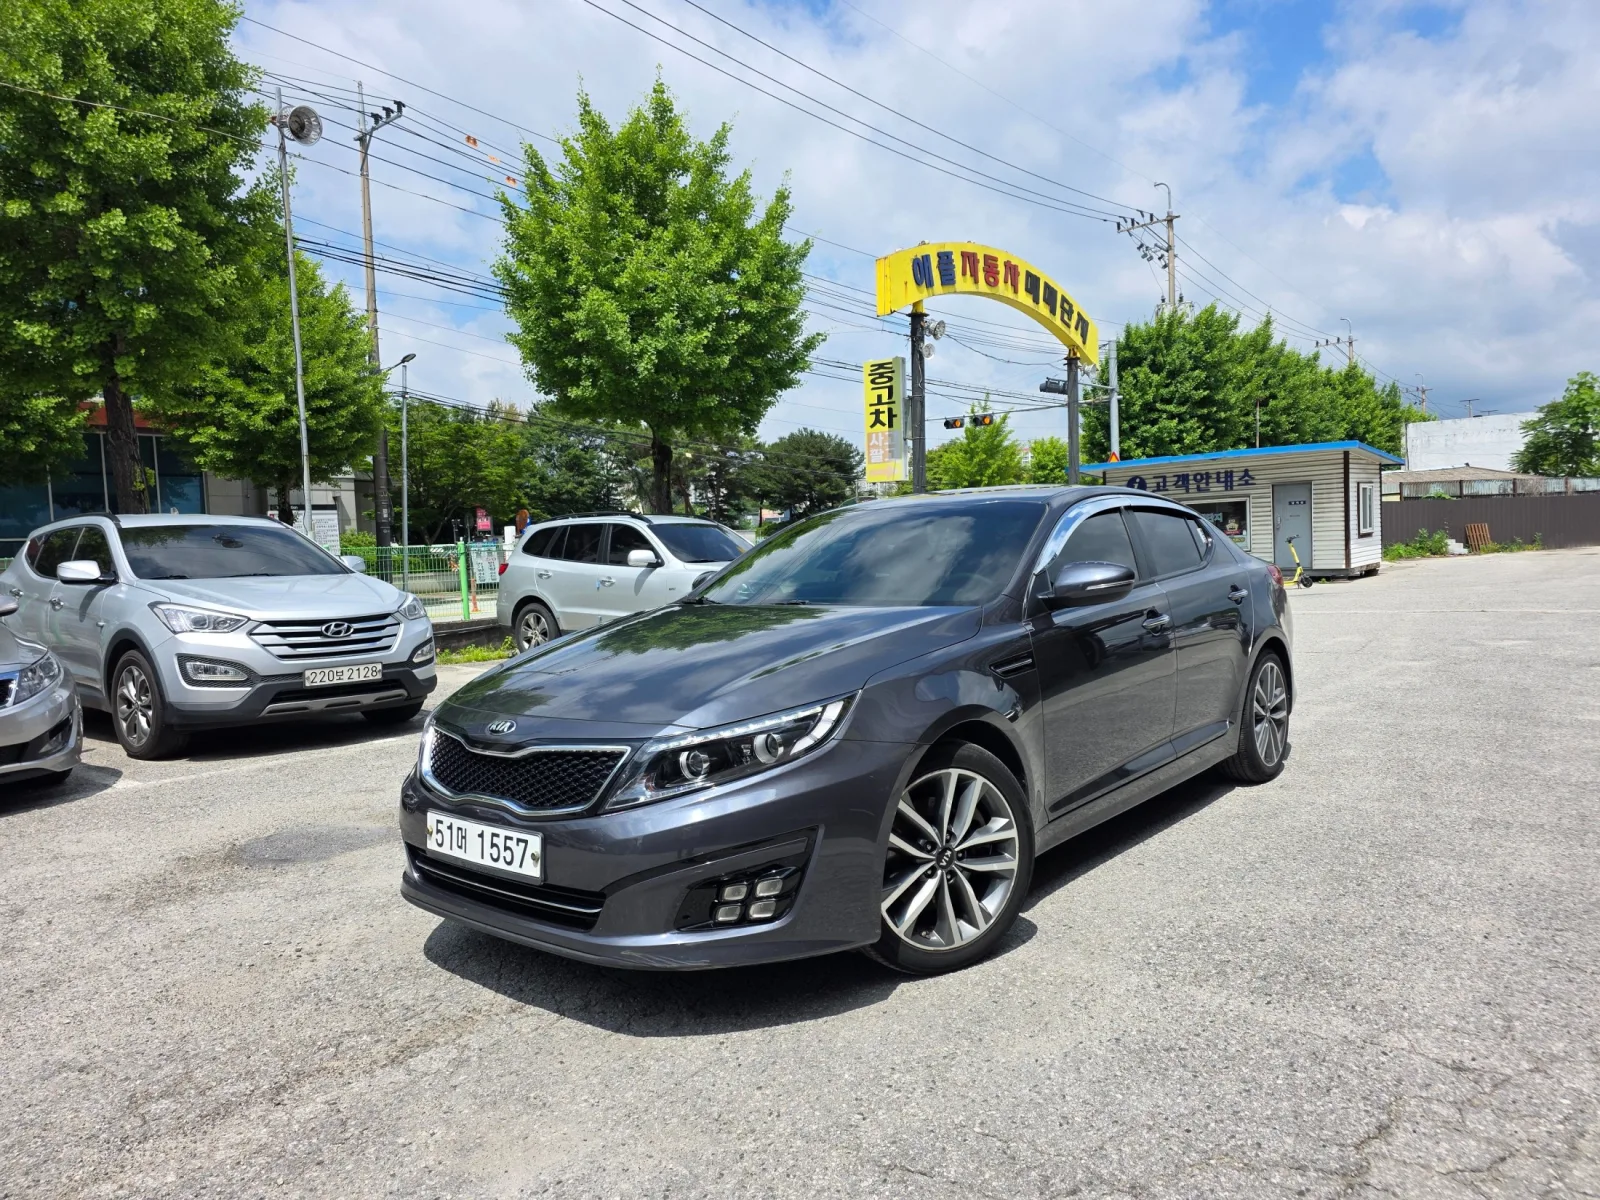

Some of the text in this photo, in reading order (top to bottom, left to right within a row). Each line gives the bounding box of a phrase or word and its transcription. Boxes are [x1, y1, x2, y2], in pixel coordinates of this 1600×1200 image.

[912, 250, 1089, 346] 애플 자동차 매매단지
[868, 361, 898, 429] 중고차
[1152, 468, 1257, 493] 고객안내소
[310, 665, 378, 684] 220보 2128
[435, 819, 529, 868] 51머 1557
